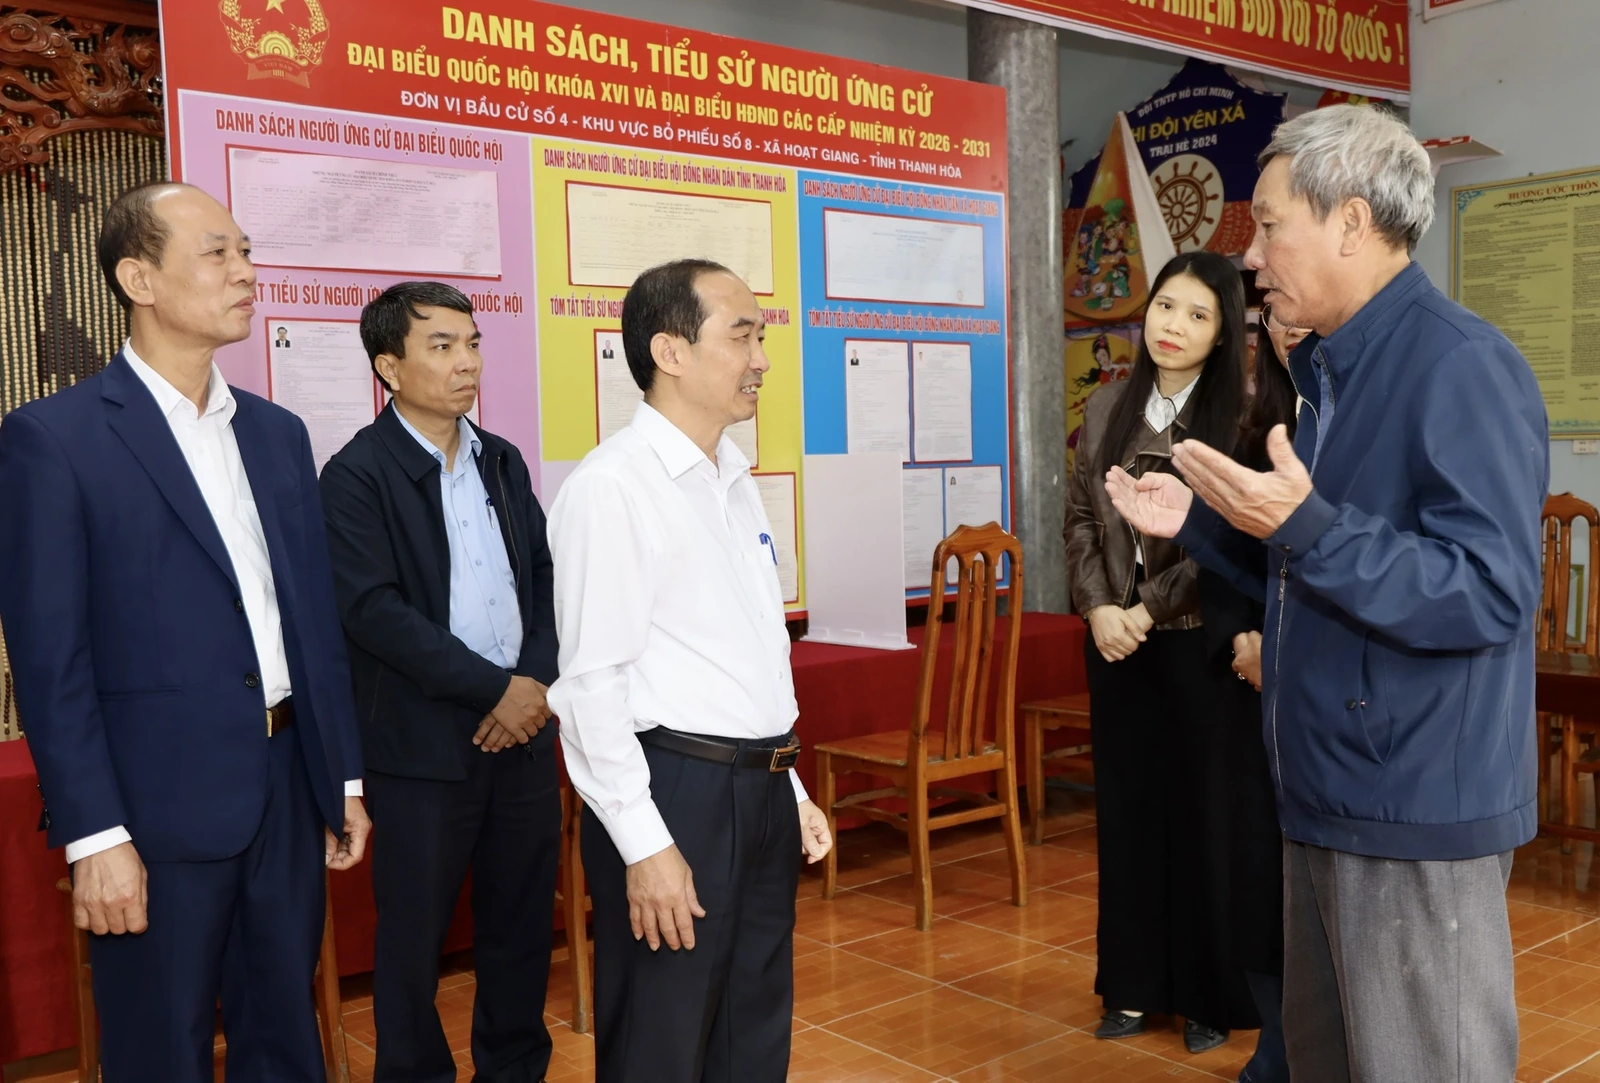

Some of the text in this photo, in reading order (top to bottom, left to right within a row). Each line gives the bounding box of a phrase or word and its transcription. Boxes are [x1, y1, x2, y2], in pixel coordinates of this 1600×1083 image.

[1340, 4, 1392, 64] QUỐC
[1395, 23, 1405, 66] !
[442, 6, 934, 117] DANH SÁCH, TIỂU SỬ NGƯỜI ỨNG CỬ
[347, 42, 385, 73] ĐẠI
[392, 45, 440, 78] BIỂU
[446, 55, 501, 87] QUỐC
[507, 65, 540, 95] HỘI
[545, 73, 596, 101] KHÓA
[600, 81, 630, 106] XVI
[634, 84, 657, 110] VÀ
[661, 91, 690, 118] ĐẠI
[695, 91, 732, 120] BIỂU
[736, 102, 779, 127] HĐND
[783, 108, 813, 132] CÁC
[817, 111, 846, 137] CẤP
[850, 120, 895, 146] NHIỆM
[898, 126, 916, 147] KỲ
[919, 131, 951, 153] 2026
[961, 138, 991, 158] 2031
[1154, 92, 1177, 108] TNTP
[1208, 87, 1234, 100] MINH
[400, 90, 439, 110] ĐƠN
[444, 95, 461, 115] VỊ
[465, 95, 501, 118] BẦU
[505, 100, 529, 121] CỬ
[533, 105, 556, 125] SỐ
[559, 112, 568, 127] 4
[582, 115, 615, 133] KHU
[618, 119, 649, 138] VỰC
[652, 121, 674, 140] BỎ
[677, 126, 720, 146] PHIẾU
[722, 131, 742, 149] SỐ
[744, 138, 753, 151] 8
[763, 139, 781, 155] XÃ
[784, 143, 818, 161] HOẠT
[821, 148, 860, 165] GIANG
[869, 151, 896, 170] TỈNH
[898, 159, 937, 176] THANH
[939, 163, 962, 179] HÓA
[1131, 99, 1246, 143] HI ĐỘI YÊN XÁ
[215, 109, 503, 165] DANH SÁCH NGƯỜI ỨNG CỬ ĐẠI BIỂU QUỐC HỘI
[1149, 143, 1174, 157] TRẠI
[1192, 133, 1218, 149] 2024
[544, 148, 565, 168] DANH
[566, 147, 587, 171] SÁCH
[588, 150, 611, 173] NGƯỜI
[611, 152, 627, 175] ỨNG
[628, 153, 638, 177] CỬ
[639, 159, 652, 182] ĐẠI
[669, 160, 682, 185] HỘI
[702, 164, 721, 186] NHÂN
[722, 166, 736, 188] DÂN
[736, 165, 751, 189] TỈNH
[752, 172, 773, 191] THANH
[774, 172, 787, 193] HÓA
[803, 179, 821, 197] DANH
[822, 178, 839, 199] SÁCH
[1507, 188, 1545, 201] HƯƠNG
[1570, 180, 1599, 192] THÔN
[269, 275, 298, 304] TIỂU
[302, 278, 321, 305] SỬ
[324, 283, 364, 307] NGƯỜI
[470, 287, 523, 318] QUỐC HỘI
[550, 294, 566, 316] TÓM
[566, 292, 579, 317] TẮT
[580, 292, 596, 318] TIỂU
[597, 294, 607, 318] SỬ
[778, 306, 791, 326] HÓA
[808, 306, 821, 328] TÓM
